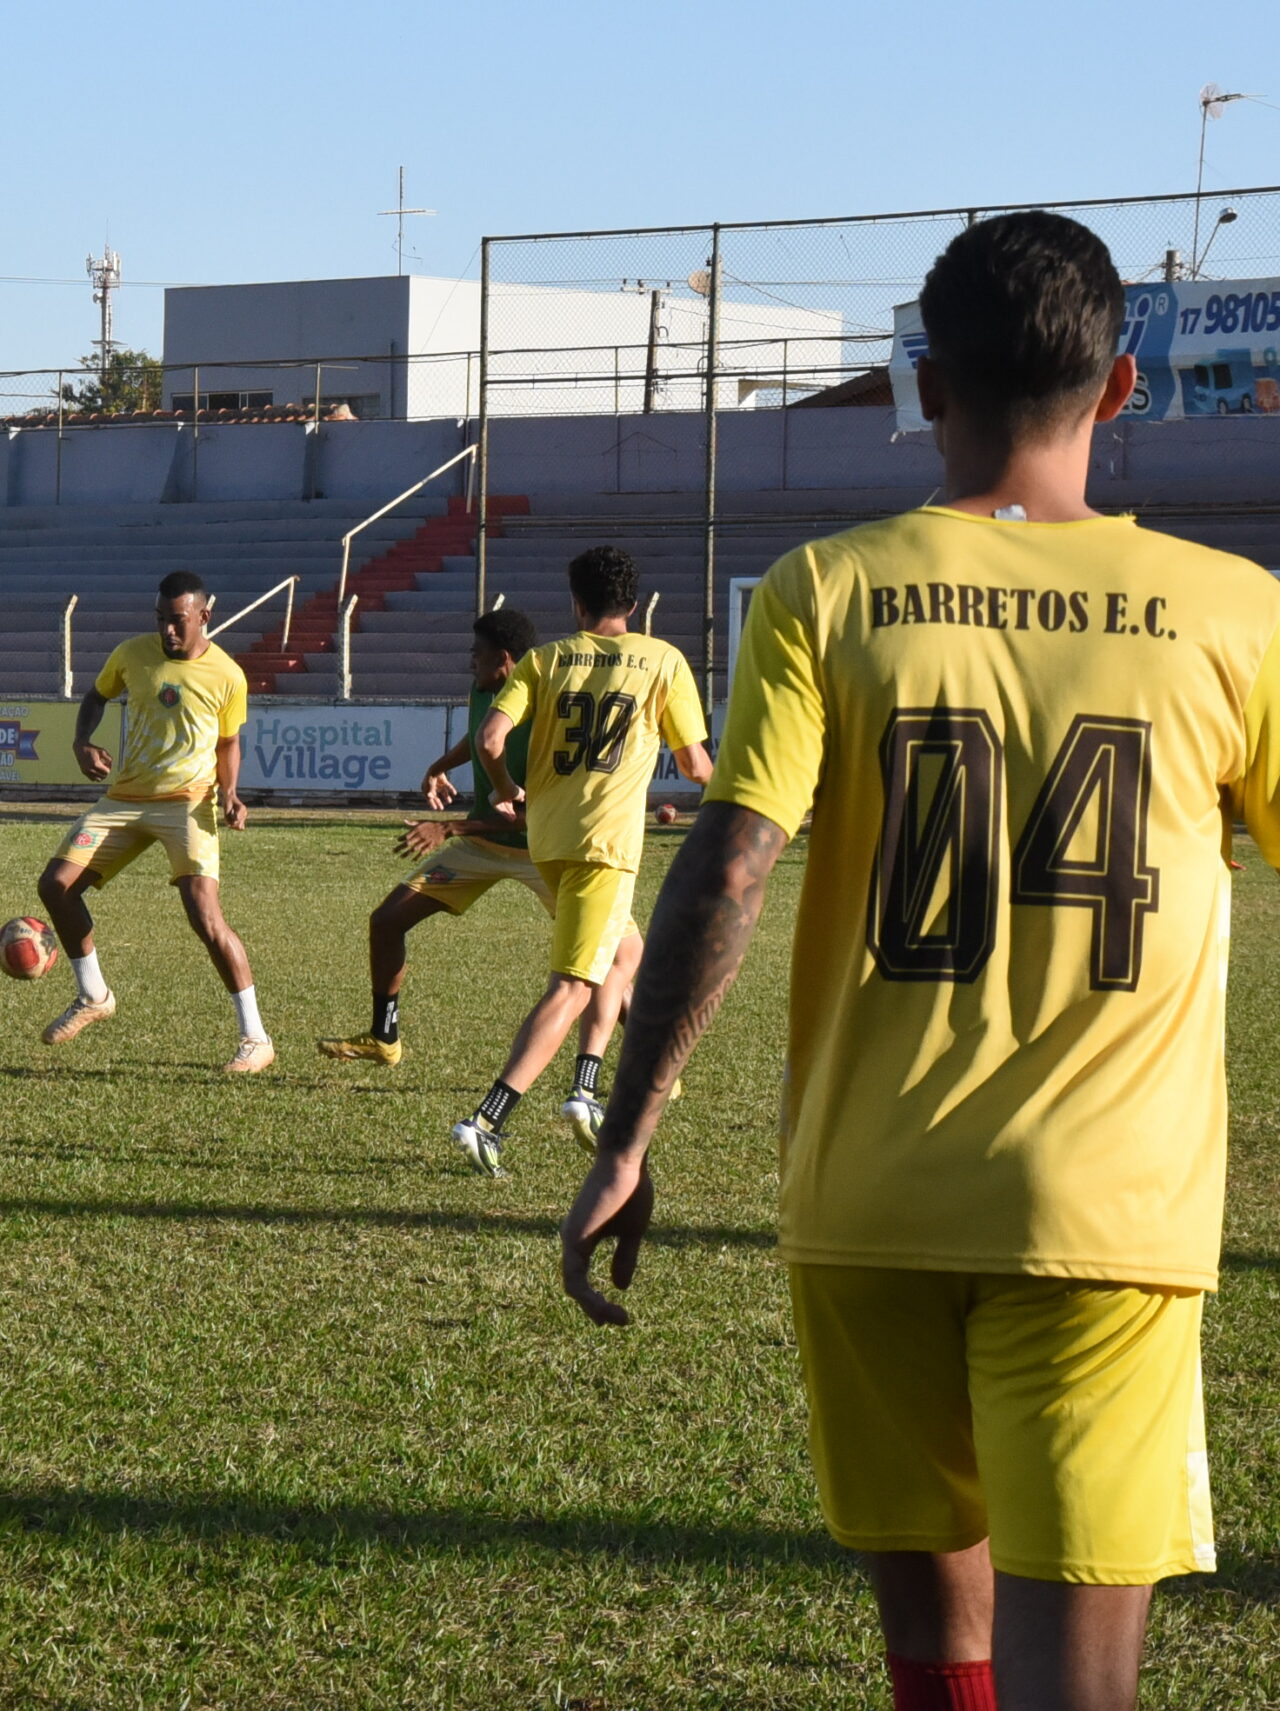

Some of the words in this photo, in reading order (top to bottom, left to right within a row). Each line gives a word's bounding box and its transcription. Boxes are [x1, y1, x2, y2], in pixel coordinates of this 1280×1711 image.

[1180, 308, 1202, 334] 17
[870, 582, 1089, 633] BARRETOS
[1103, 592, 1177, 640] E.C.
[558, 652, 623, 668] BARRETOS
[626, 654, 649, 671] E.C.
[256, 719, 393, 752] Hospital
[554, 691, 637, 776] 30
[255, 745, 391, 788] Village
[866, 707, 1160, 993] 04
